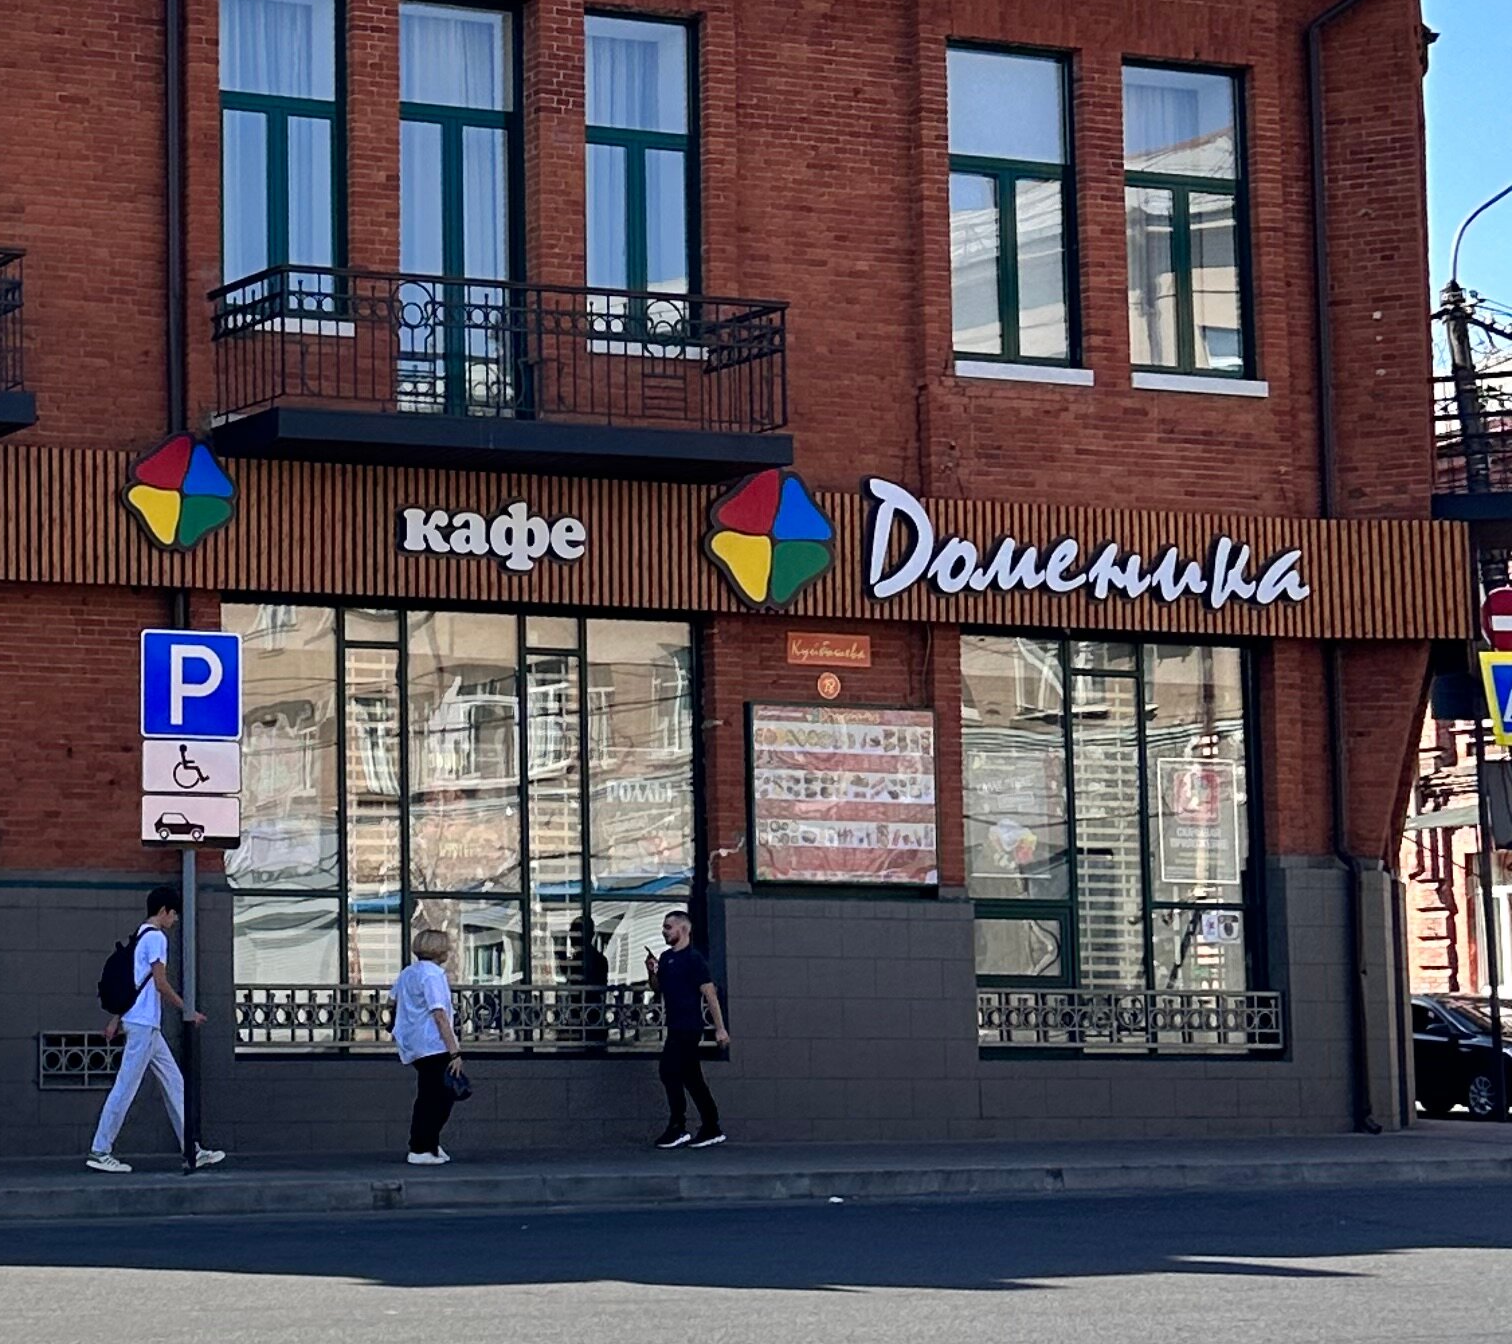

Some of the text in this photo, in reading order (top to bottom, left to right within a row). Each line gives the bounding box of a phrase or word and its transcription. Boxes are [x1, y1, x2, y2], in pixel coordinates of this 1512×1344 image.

[402, 501, 587, 572] кафе
[868, 477, 1311, 609] Доменика
[170, 644, 224, 726] P
